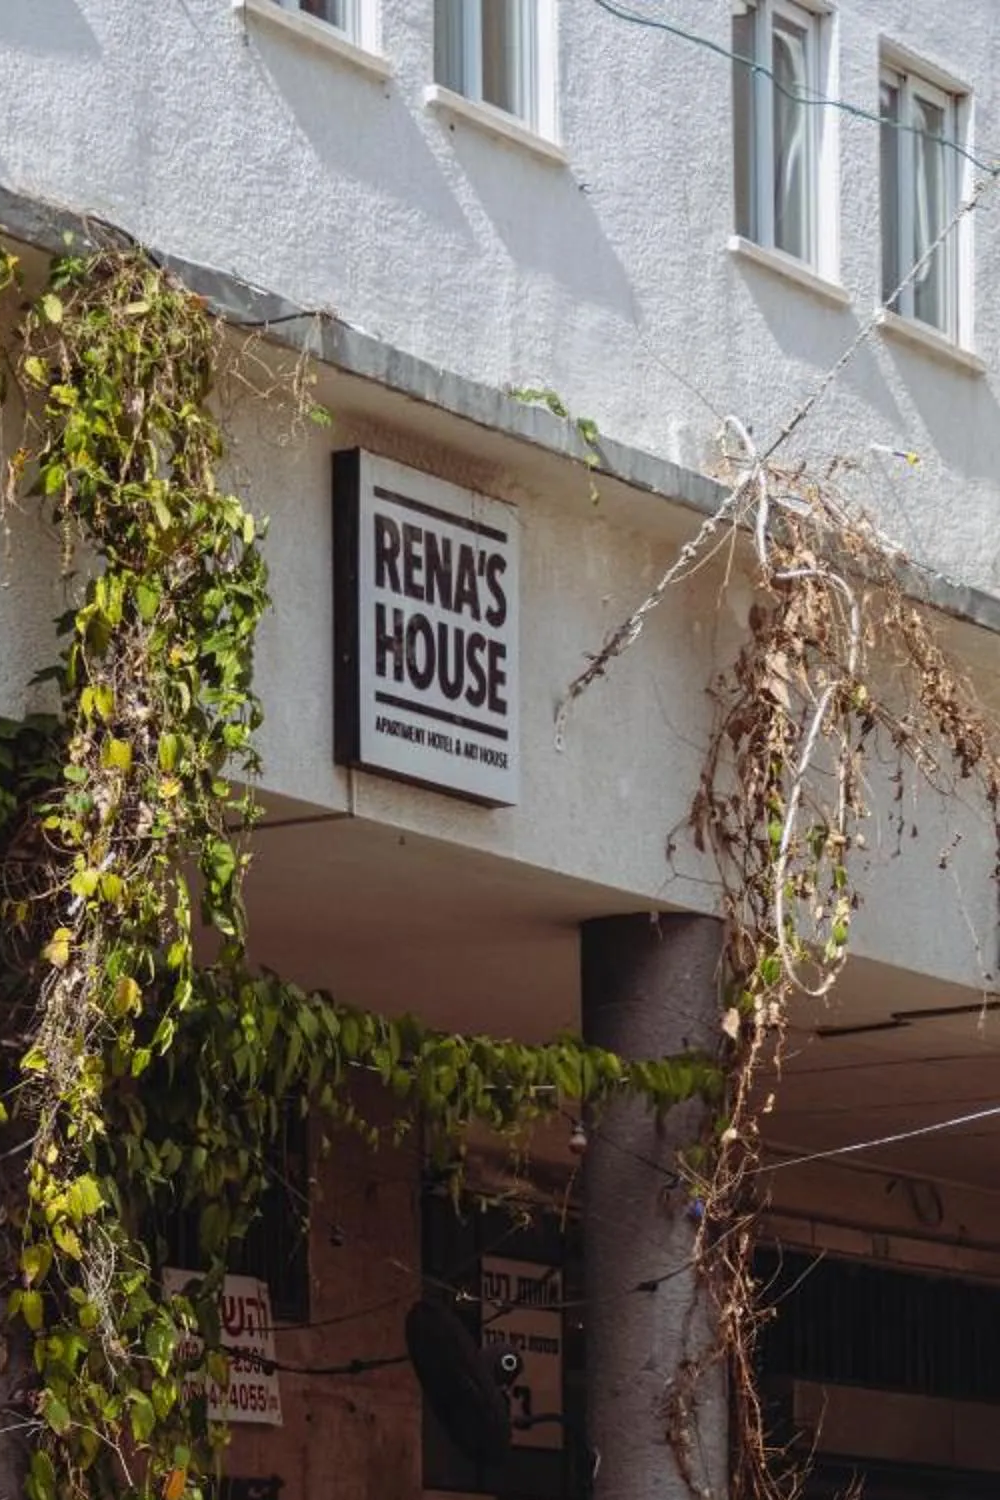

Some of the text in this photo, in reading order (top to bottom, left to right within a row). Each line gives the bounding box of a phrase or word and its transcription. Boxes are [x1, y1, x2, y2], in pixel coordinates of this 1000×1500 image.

[374, 513, 507, 629] RENA'S
[375, 603, 507, 716] HOUSE
[376, 715, 425, 746] APARTMENT
[428, 730, 453, 756] HOTEL
[480, 746, 508, 769] HOUSE
